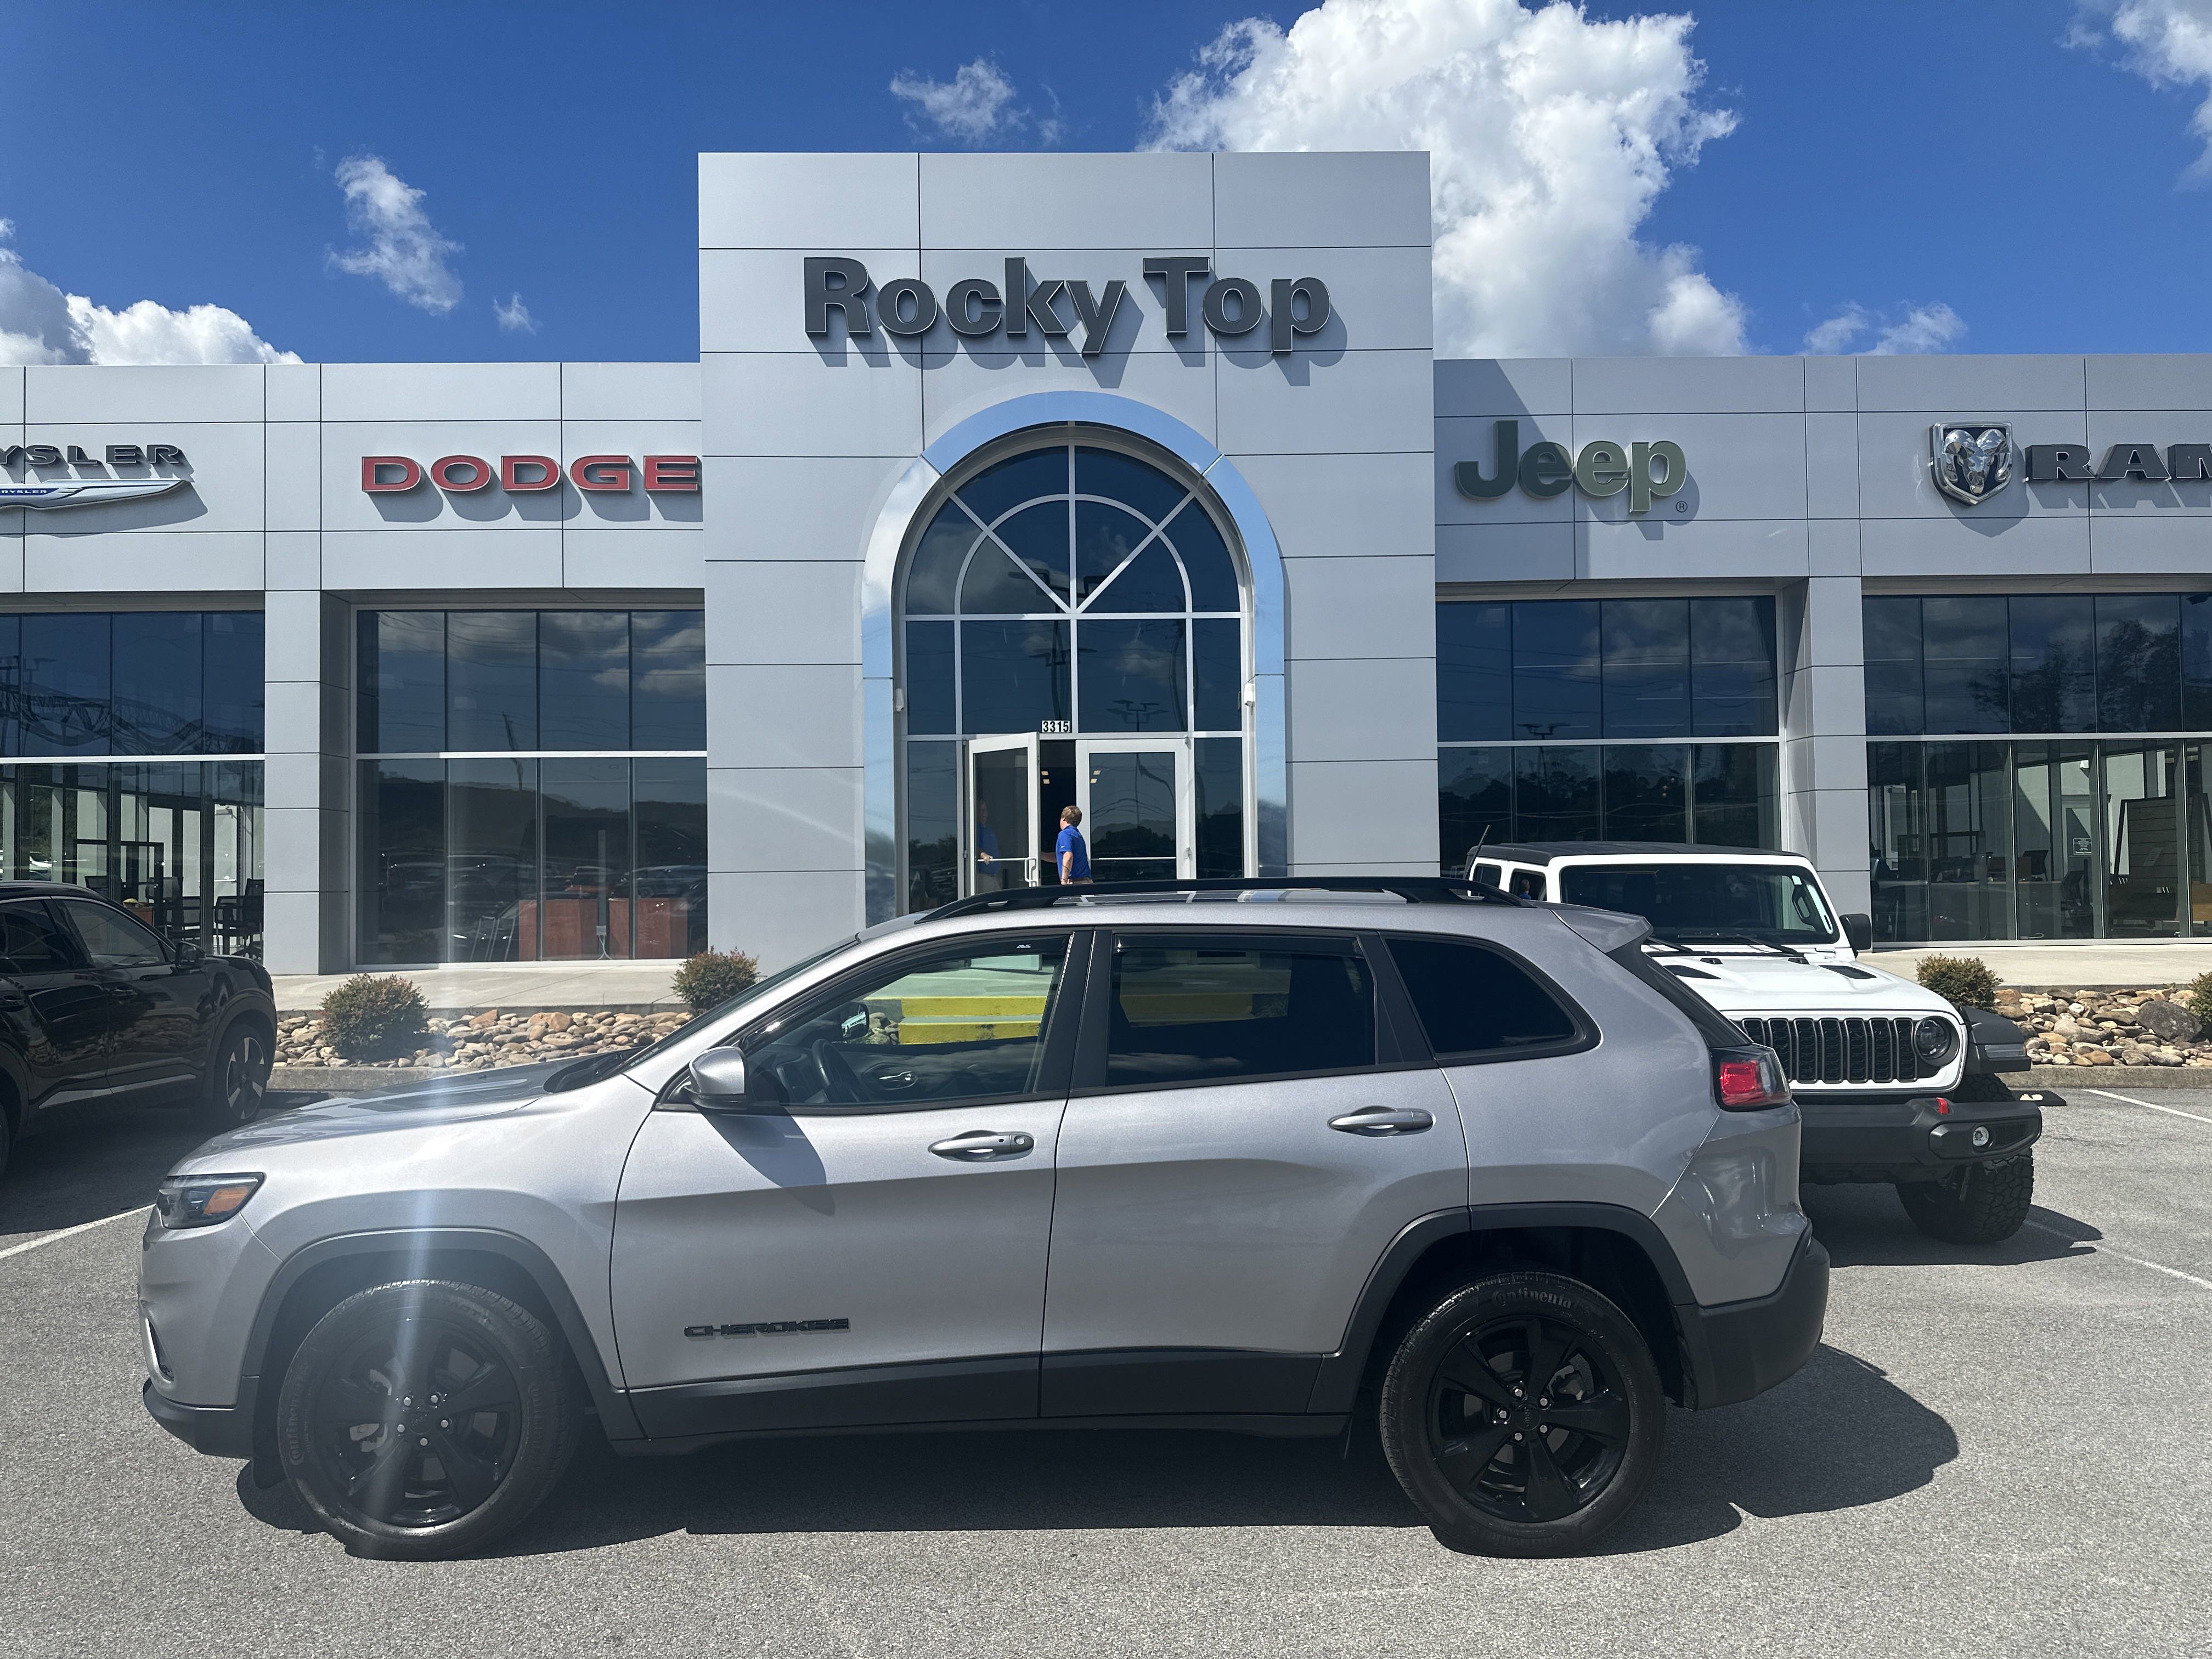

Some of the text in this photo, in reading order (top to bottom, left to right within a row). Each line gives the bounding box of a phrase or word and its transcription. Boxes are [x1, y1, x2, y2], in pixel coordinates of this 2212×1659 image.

[804, 256, 1331, 357] Rocky Top
[362, 455, 699, 492] DODGE
[1454, 420, 1687, 512] Jeep
[1043, 721, 1069, 732] 3315
[684, 1318, 850, 1337] CHEROKEE
